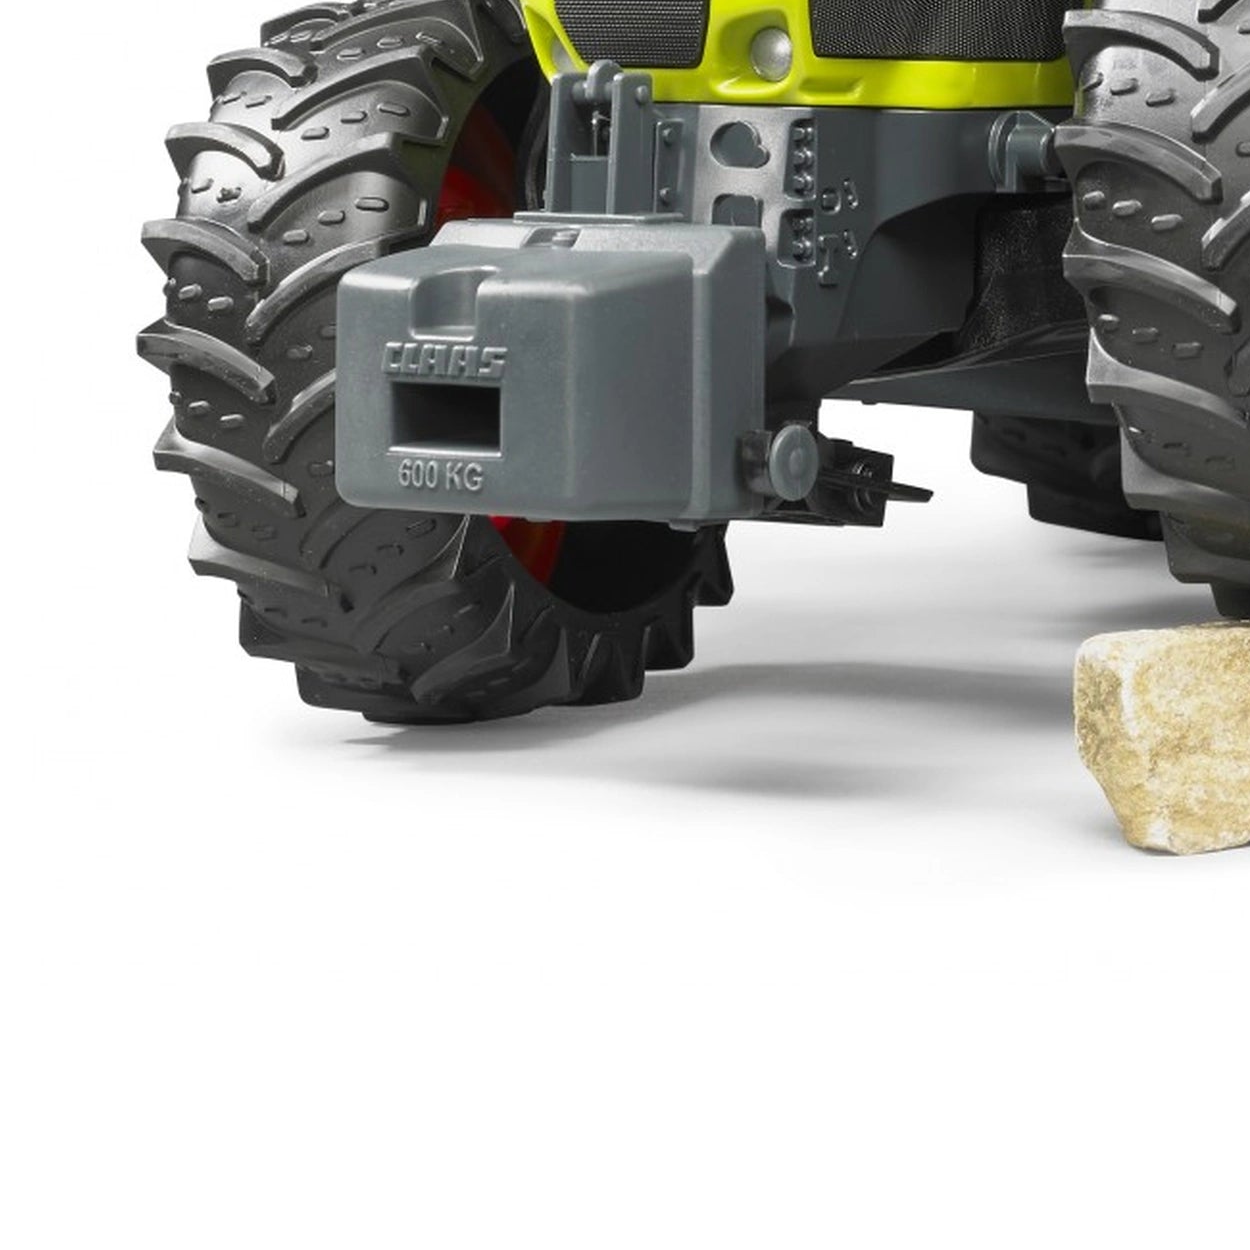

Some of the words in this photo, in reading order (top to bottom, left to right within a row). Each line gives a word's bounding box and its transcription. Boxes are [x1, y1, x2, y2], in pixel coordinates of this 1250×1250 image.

[381, 341, 509, 380] CLAAS
[397, 457, 439, 489] 600
[445, 461, 485, 492] KG
